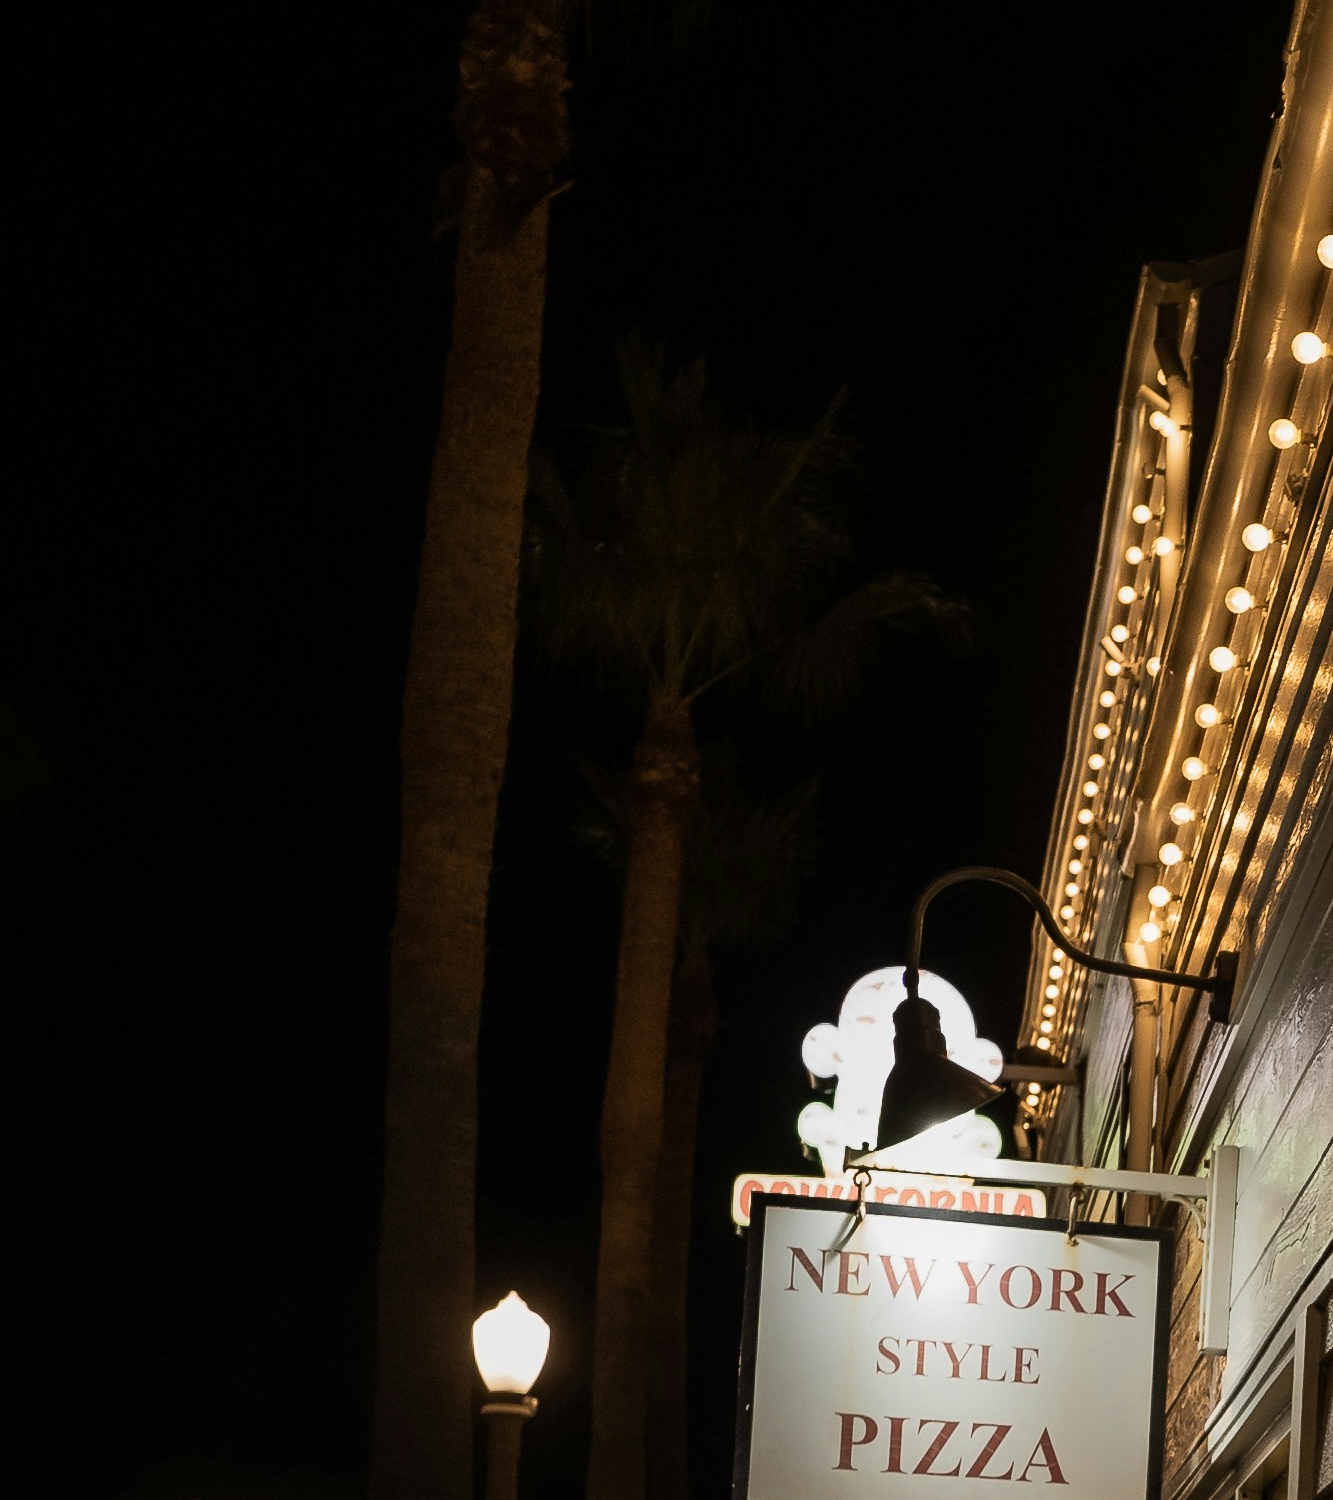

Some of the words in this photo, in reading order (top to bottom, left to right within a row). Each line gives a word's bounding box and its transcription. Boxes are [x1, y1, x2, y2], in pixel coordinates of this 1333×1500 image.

[784, 1245, 936, 1301] NEW
[957, 1261, 1136, 1318] YORK
[875, 1336, 1041, 1384] STYLE
[831, 1411, 1070, 1485] PIZZA
